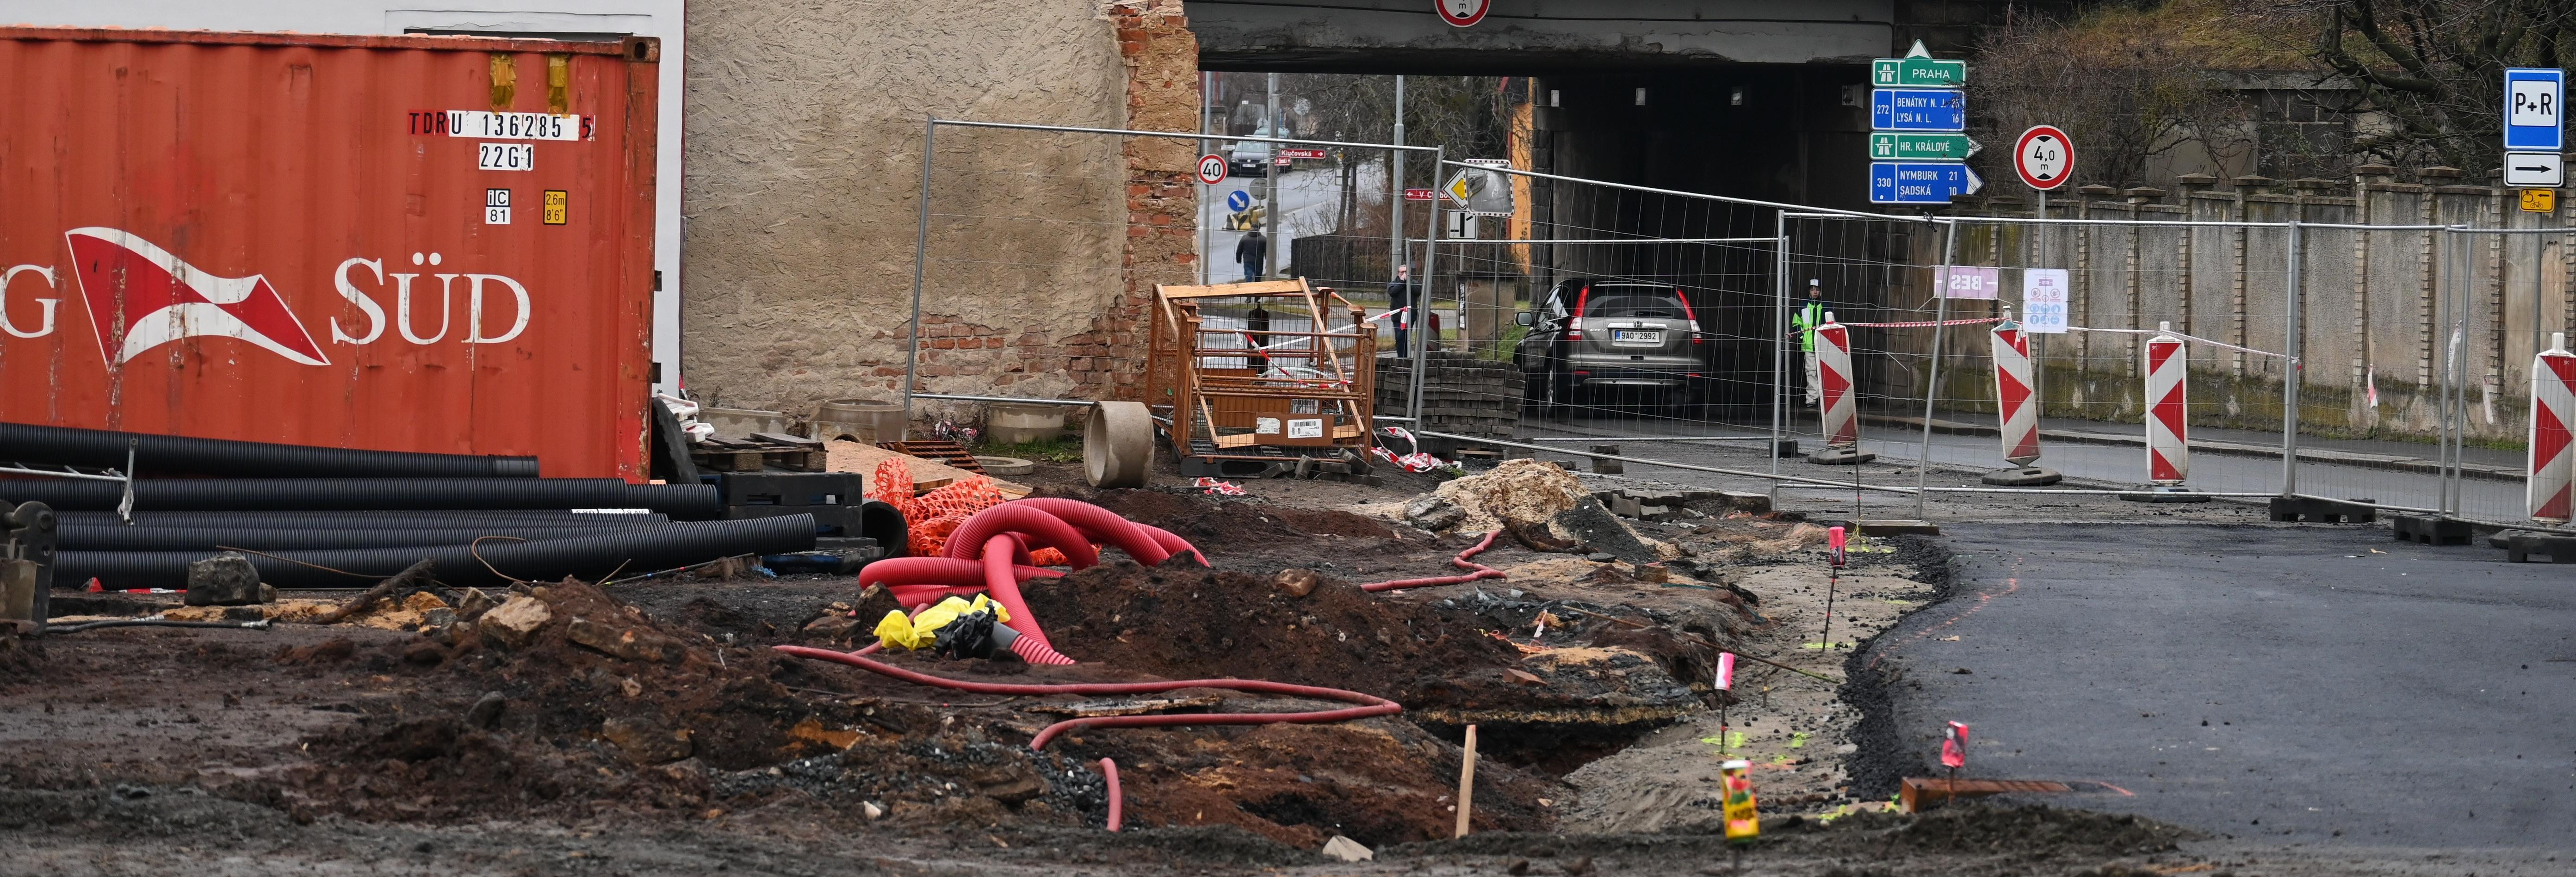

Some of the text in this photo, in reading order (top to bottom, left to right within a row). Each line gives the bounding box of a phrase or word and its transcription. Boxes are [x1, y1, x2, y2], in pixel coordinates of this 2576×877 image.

[1912, 69, 1950, 79] PRAHA
[1897, 96, 1927, 107] BENÁTKY
[1931, 98, 1937, 108] N.
[2515, 93, 2552, 115] P+R
[1876, 105, 1889, 114] 272
[1897, 111, 1959, 123] LYSÁ N. L. 16
[409, 112, 592, 138] TDRU 136285 5
[1900, 140, 1950, 151] HR. KRÁLOVÉ
[481, 146, 532, 168] 22G1
[2034, 146, 2055, 161] 4,0
[1203, 163, 1220, 177] 40
[1900, 171, 1957, 180] NYMBURK 21
[1877, 178, 1891, 187] 330
[1900, 184, 1957, 196] SADSKÁ 10
[546, 194, 565, 206] 2,6m
[490, 210, 506, 222] 81
[0, 252, 531, 345] G SÜD
